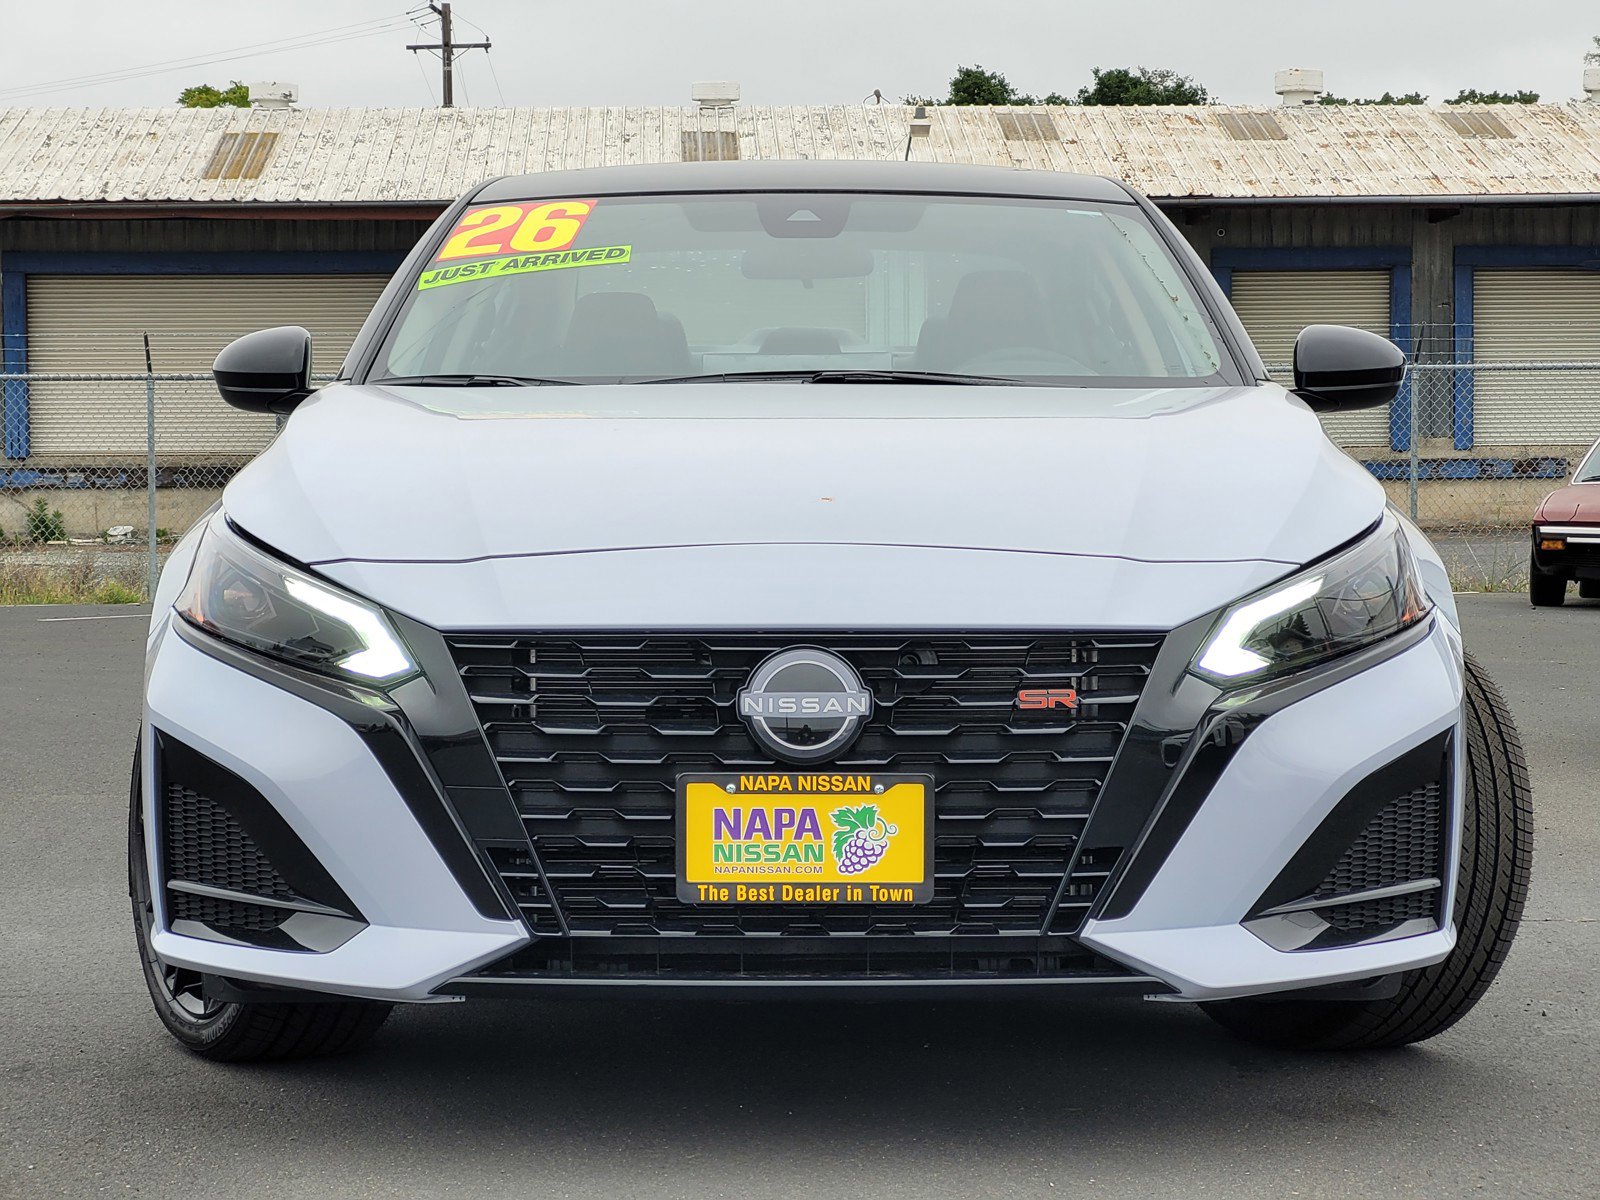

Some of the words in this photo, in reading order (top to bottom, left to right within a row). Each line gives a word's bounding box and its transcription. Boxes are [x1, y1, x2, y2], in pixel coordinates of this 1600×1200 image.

[438, 201, 591, 260] 26
[423, 261, 497, 284] JUST
[500, 248, 630, 271] ARRIVED
[744, 697, 866, 713] NISSAN
[1018, 689, 1078, 709] SR
[740, 775, 793, 792] NAPA
[797, 775, 871, 792] NISSAN
[713, 807, 824, 841] NAPA
[713, 843, 824, 863] NISSAN
[714, 865, 823, 874] NAPANISSAN.COM
[697, 885, 729, 902] The
[735, 885, 775, 902] Best
[781, 885, 840, 902] Dealer
[846, 885, 863, 902] in
[869, 885, 914, 902] Town
